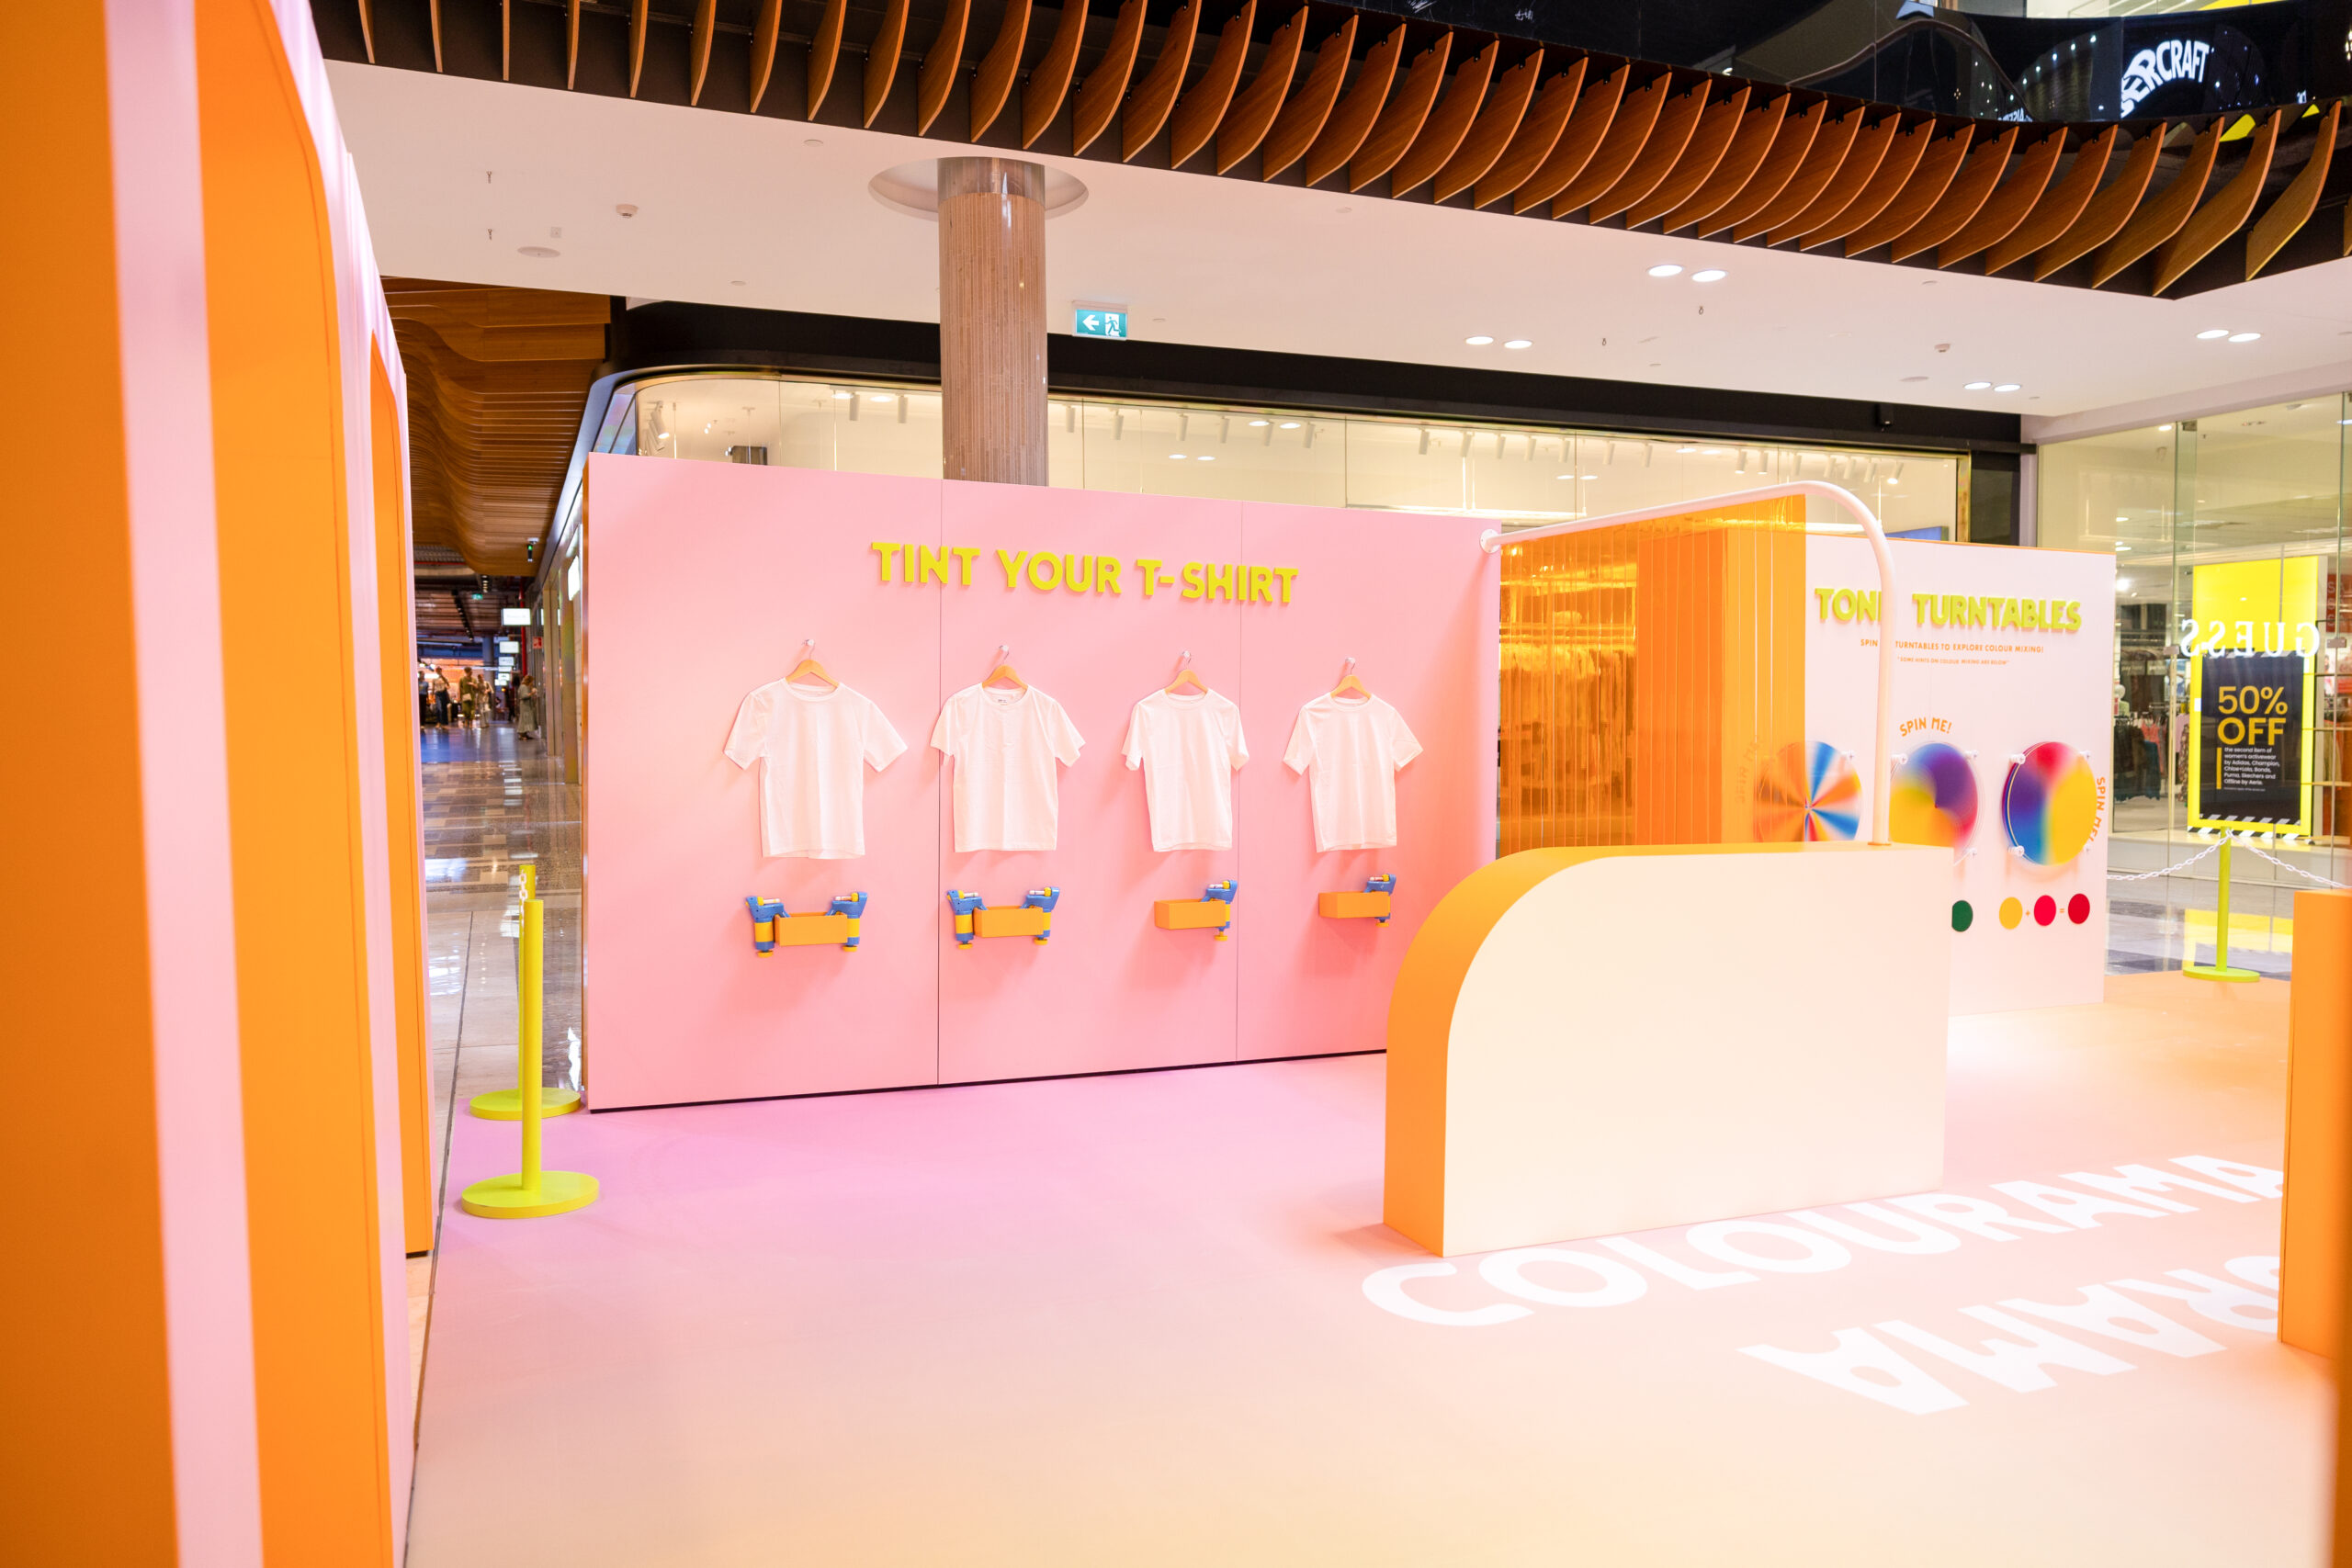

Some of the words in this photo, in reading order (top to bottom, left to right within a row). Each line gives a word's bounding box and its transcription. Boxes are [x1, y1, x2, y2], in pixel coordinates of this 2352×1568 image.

[871, 541, 980, 586] TINT
[996, 548, 1122, 594] YOUR
[1136, 558, 1299, 604] T-SHIRT
[1912, 593, 2082, 631] TURNTABLES
[1860, 638, 1878, 648] SPIN
[1895, 640, 1939, 650] TURNTABLES
[1952, 643, 1983, 651] EXPLORE
[1984, 644, 2013, 652] COLOUR
[2218, 685, 2289, 715] 50%
[1900, 717, 1927, 737] SPIN
[1931, 717, 1951, 734] ME!
[2217, 716, 2286, 745] OFF
[2097, 777, 2106, 811] SPIN
